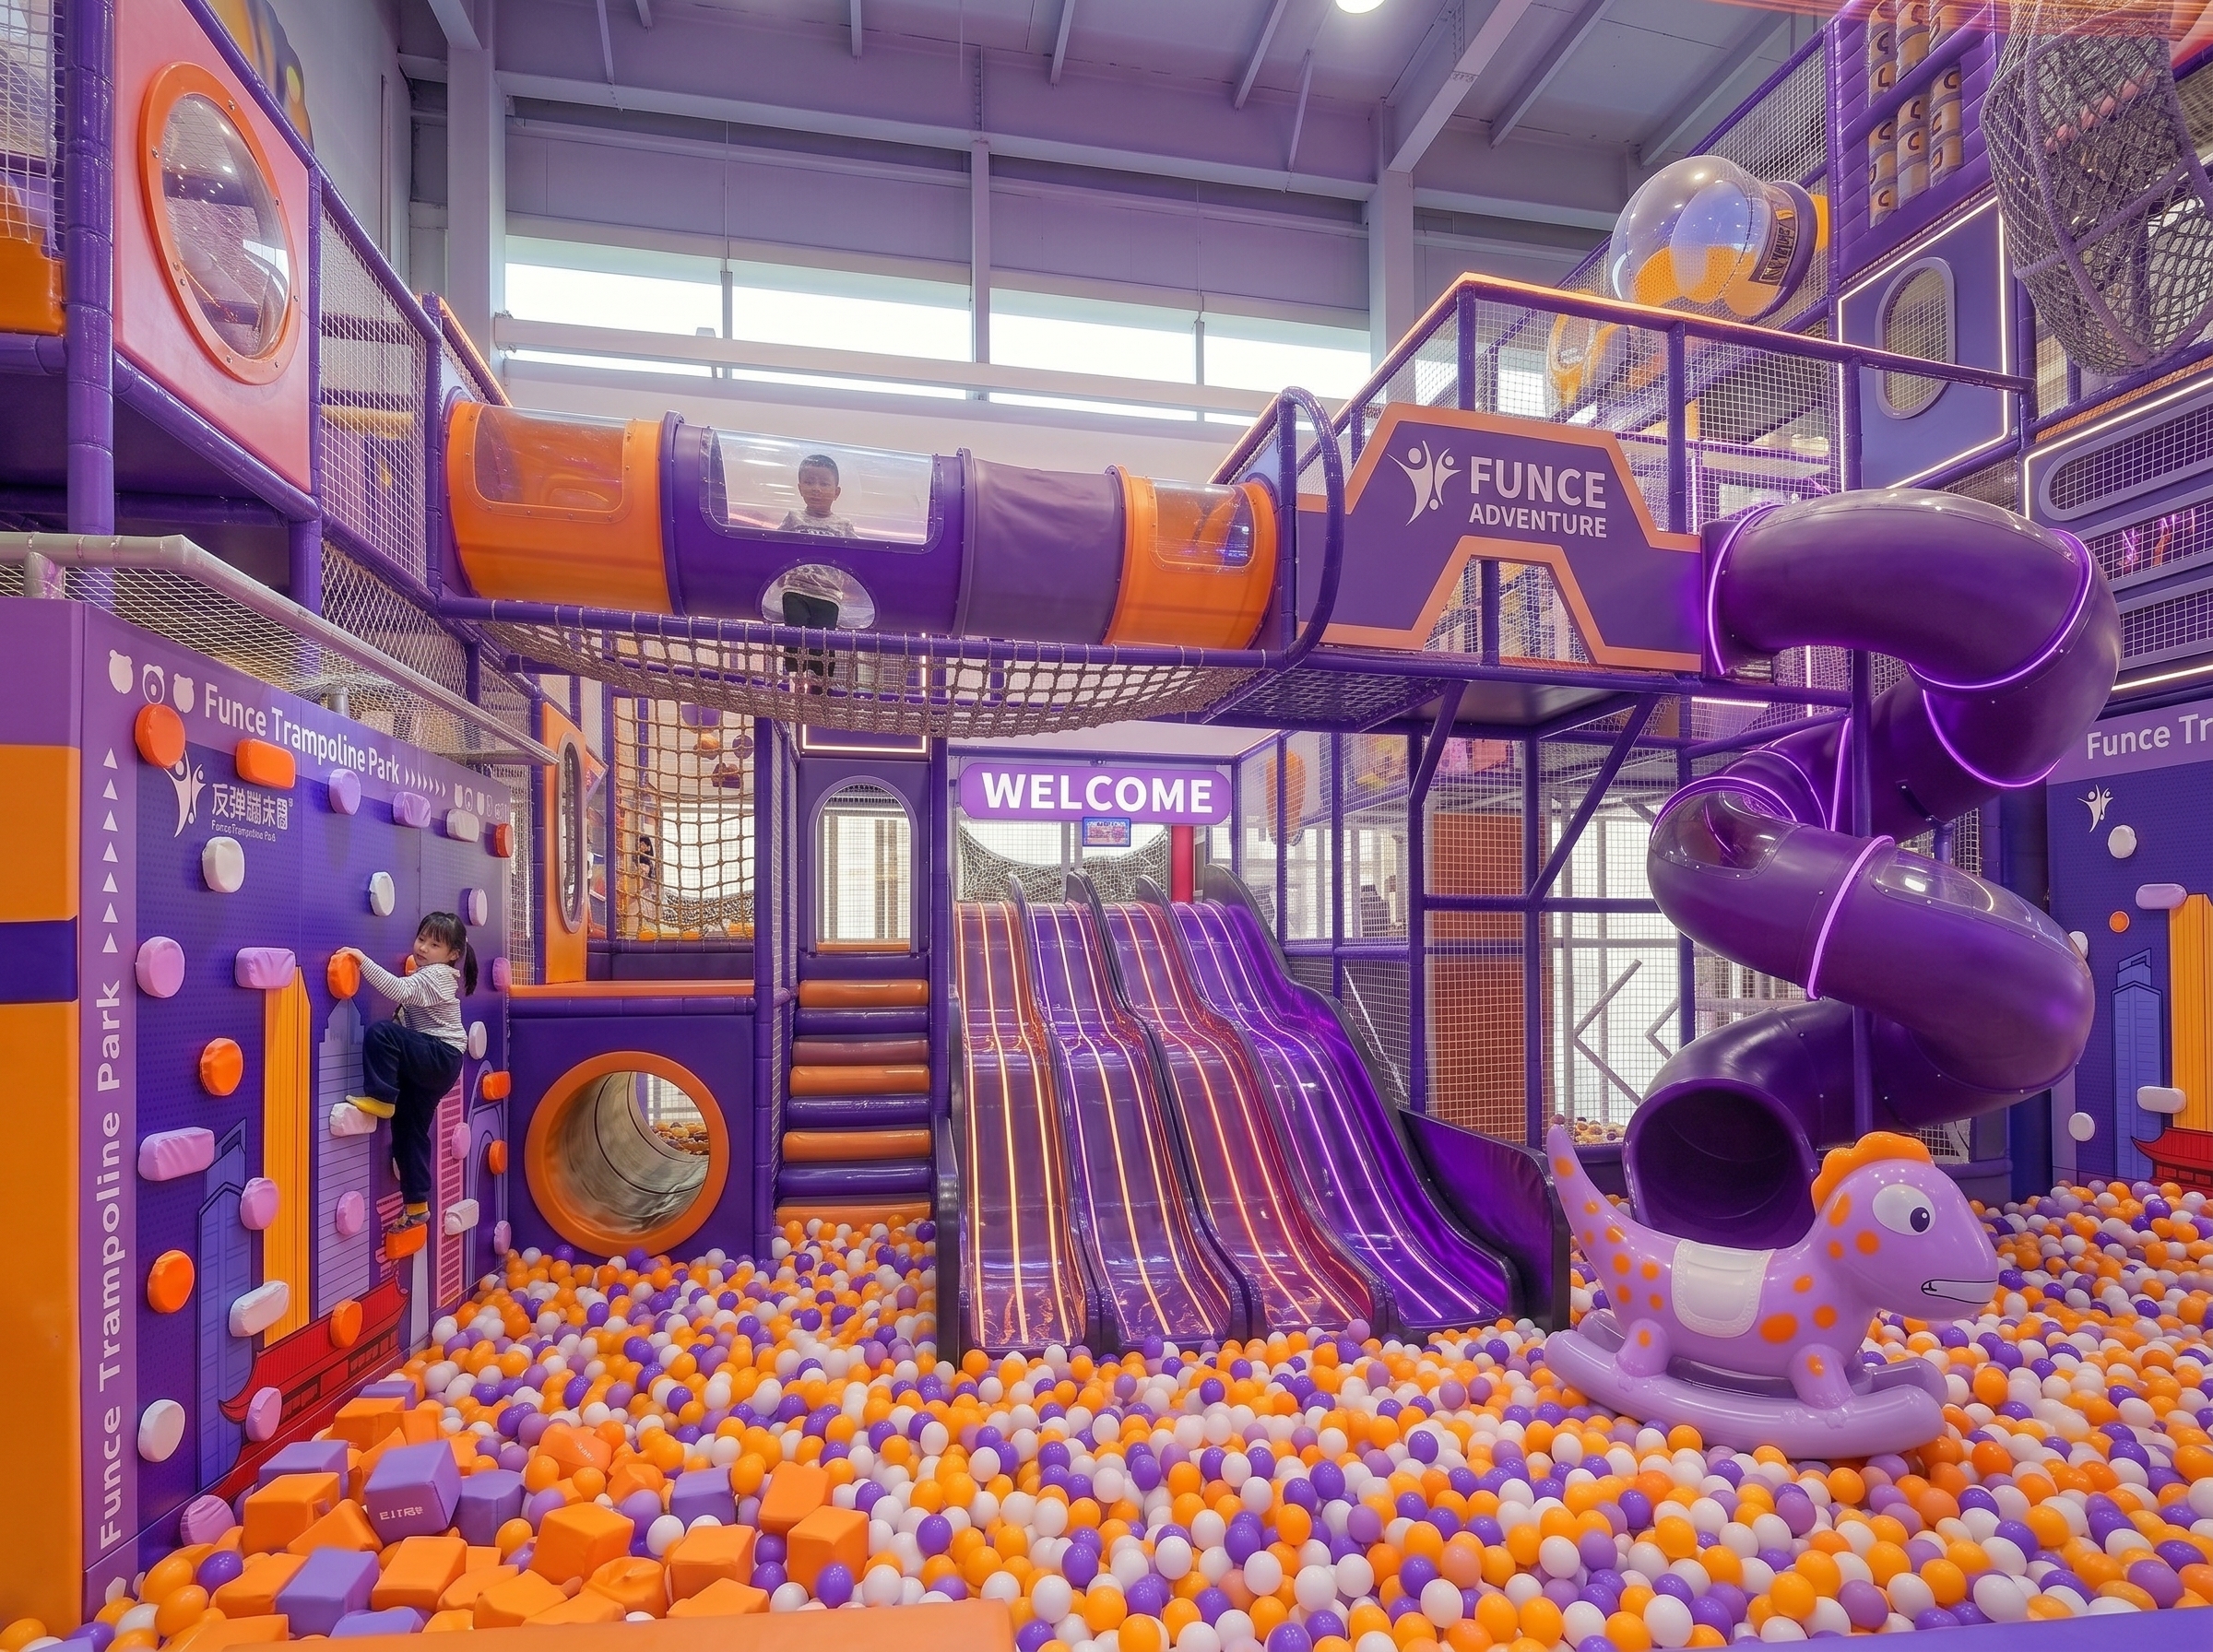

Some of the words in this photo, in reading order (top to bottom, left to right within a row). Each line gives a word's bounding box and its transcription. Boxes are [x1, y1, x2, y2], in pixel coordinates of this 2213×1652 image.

[1468, 502, 1607, 538] ADVENTURE
[1470, 455, 1606, 510] FUNCE
[205, 682, 266, 737] Funce
[271, 706, 366, 773] Trampoline
[368, 747, 400, 785] Park
[2087, 726, 2171, 760] Funce
[981, 772, 1213, 813] WELCOME
[96, 979, 120, 1092] Park
[96, 1110, 125, 1392] Trampoline
[100, 1405, 122, 1550] Funce
